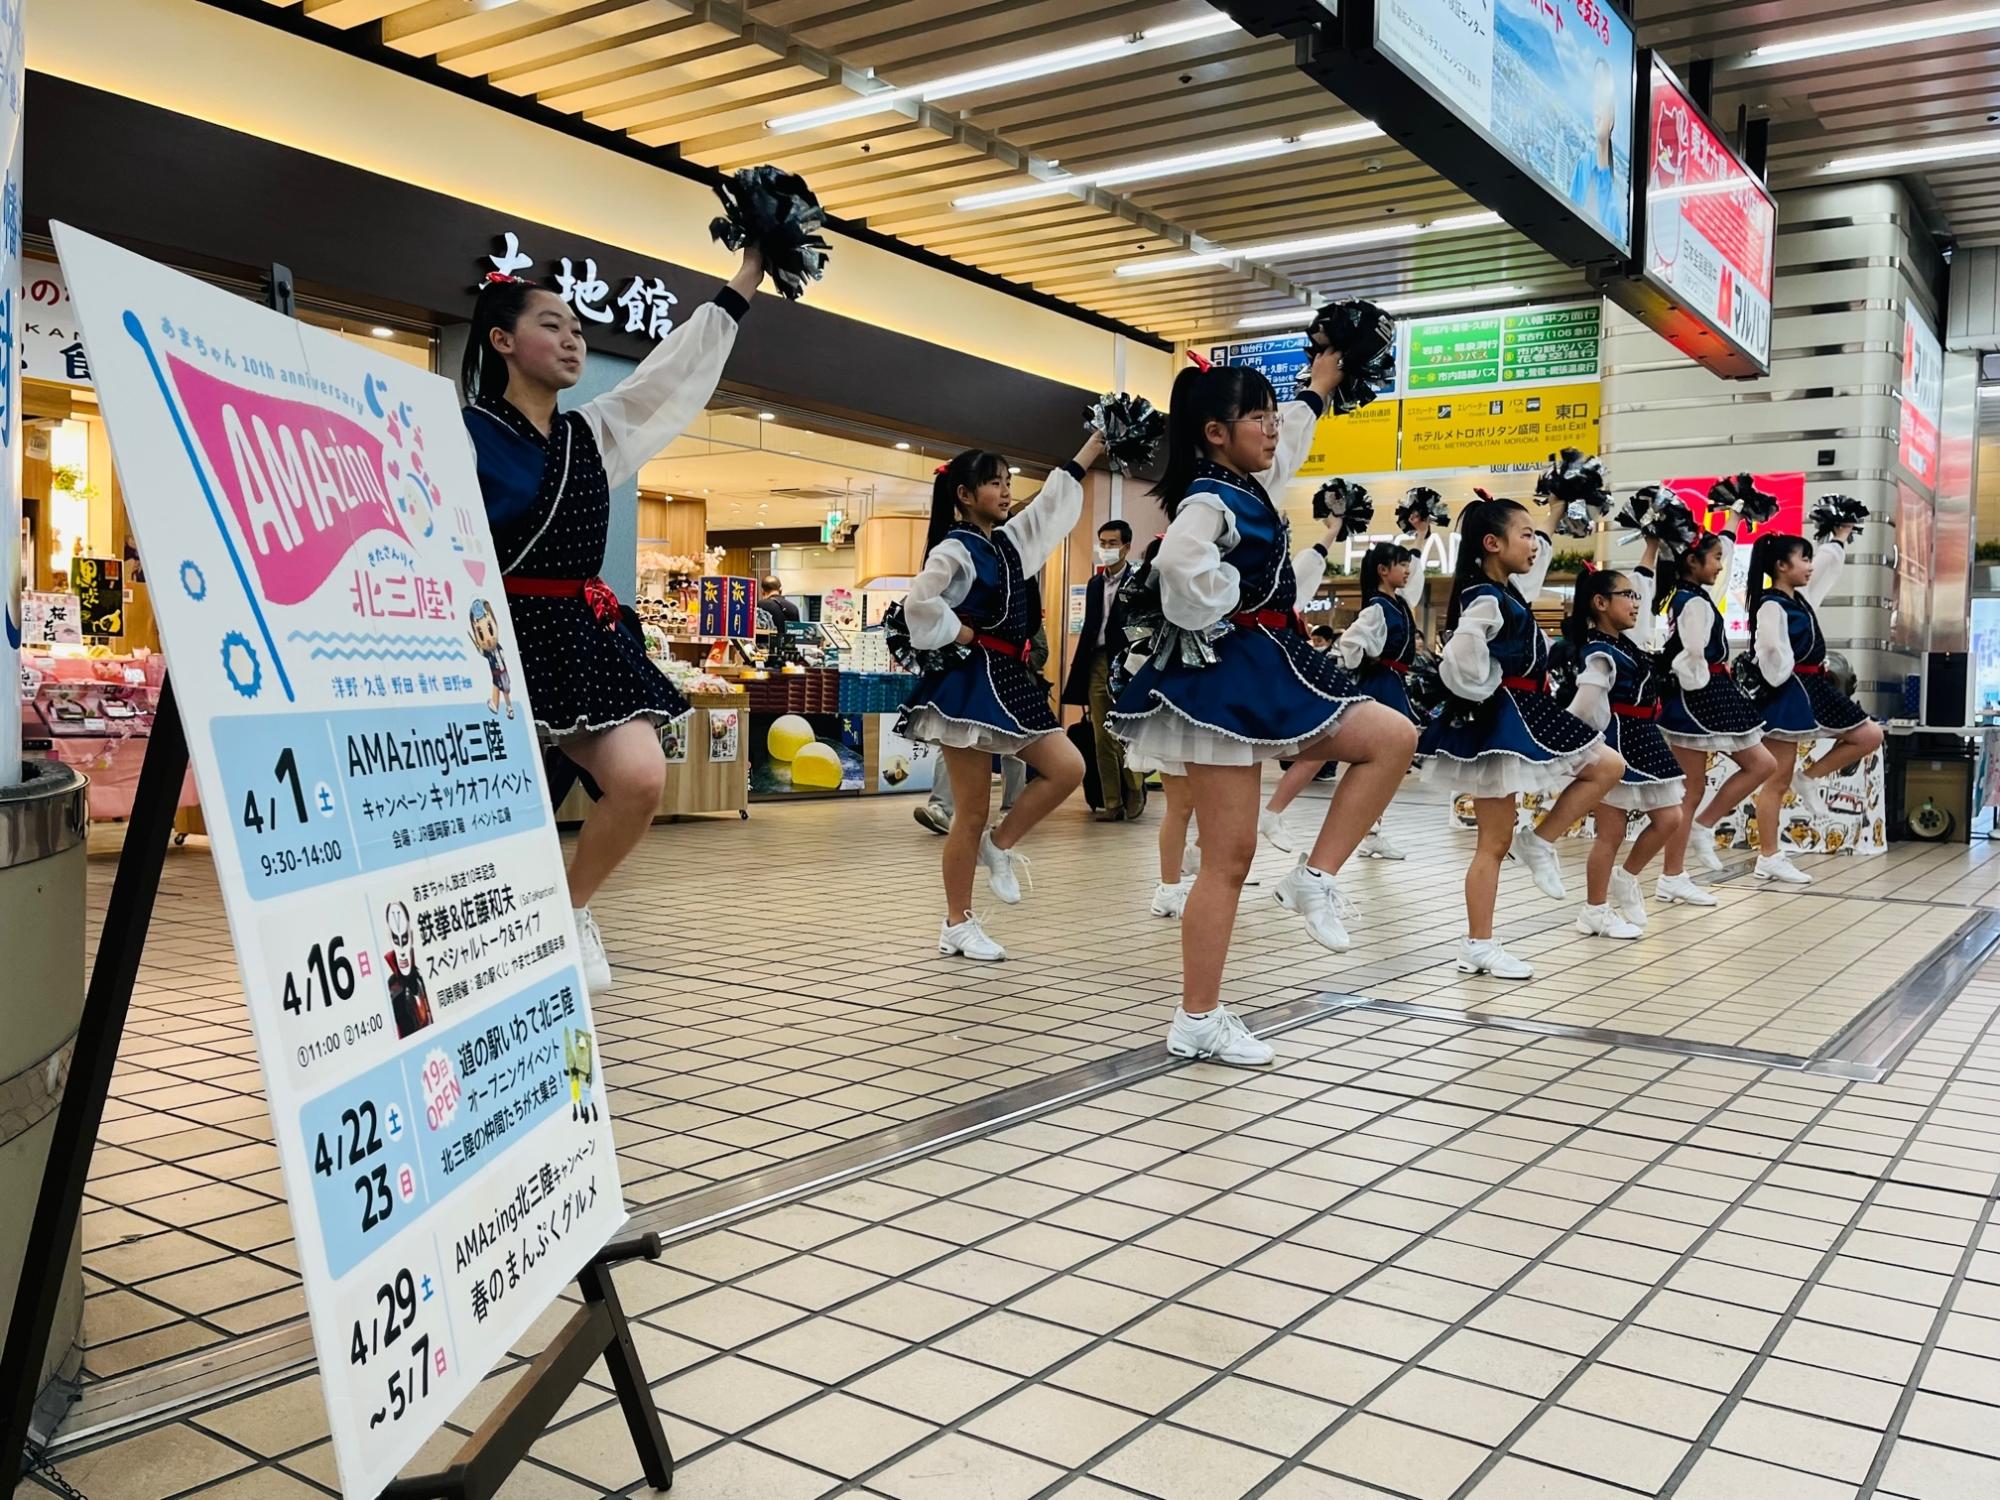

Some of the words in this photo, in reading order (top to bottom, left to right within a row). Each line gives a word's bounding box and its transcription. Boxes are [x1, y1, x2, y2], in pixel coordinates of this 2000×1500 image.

[161, 316, 236, 368] あまちゃん
[241, 354, 276, 380] 10th
[279, 367, 365, 416] anniversary
[1438, 368, 1497, 382] 市内路線バス
[1413, 423, 1540, 442] ホテルメトロポリタン盛岡
[1545, 423, 1566, 432] East
[1569, 421, 1587, 431] Exit
[1555, 403, 1588, 420] 東口
[222, 403, 395, 555] AMAzing
[368, 544, 416, 574] きたさんりく
[350, 569, 456, 621] 北三陸!
[347, 718, 508, 778] AMAzing北三陸
[243, 747, 309, 834] 4/1
[318, 786, 334, 813] 土
[260, 839, 342, 877] 9:30-14:00
[283, 936, 356, 1016] 4/16
[356, 950, 372, 978] 日
[457, 985, 576, 1080] 道の駅いわて北三陸
[426, 1074, 462, 1132] OPEN
[467, 1037, 561, 1113] オープニングイベント
[314, 1099, 384, 1178] 4/22
[388, 1109, 403, 1136] 土
[355, 1162, 394, 1233] 23
[399, 1169, 415, 1198] 日
[470, 1175, 599, 1324] 春のまんぷくグルメ
[350, 1266, 416, 1367] 4/29
[420, 1274, 435, 1302] 土
[434, 1346, 448, 1378] 日
